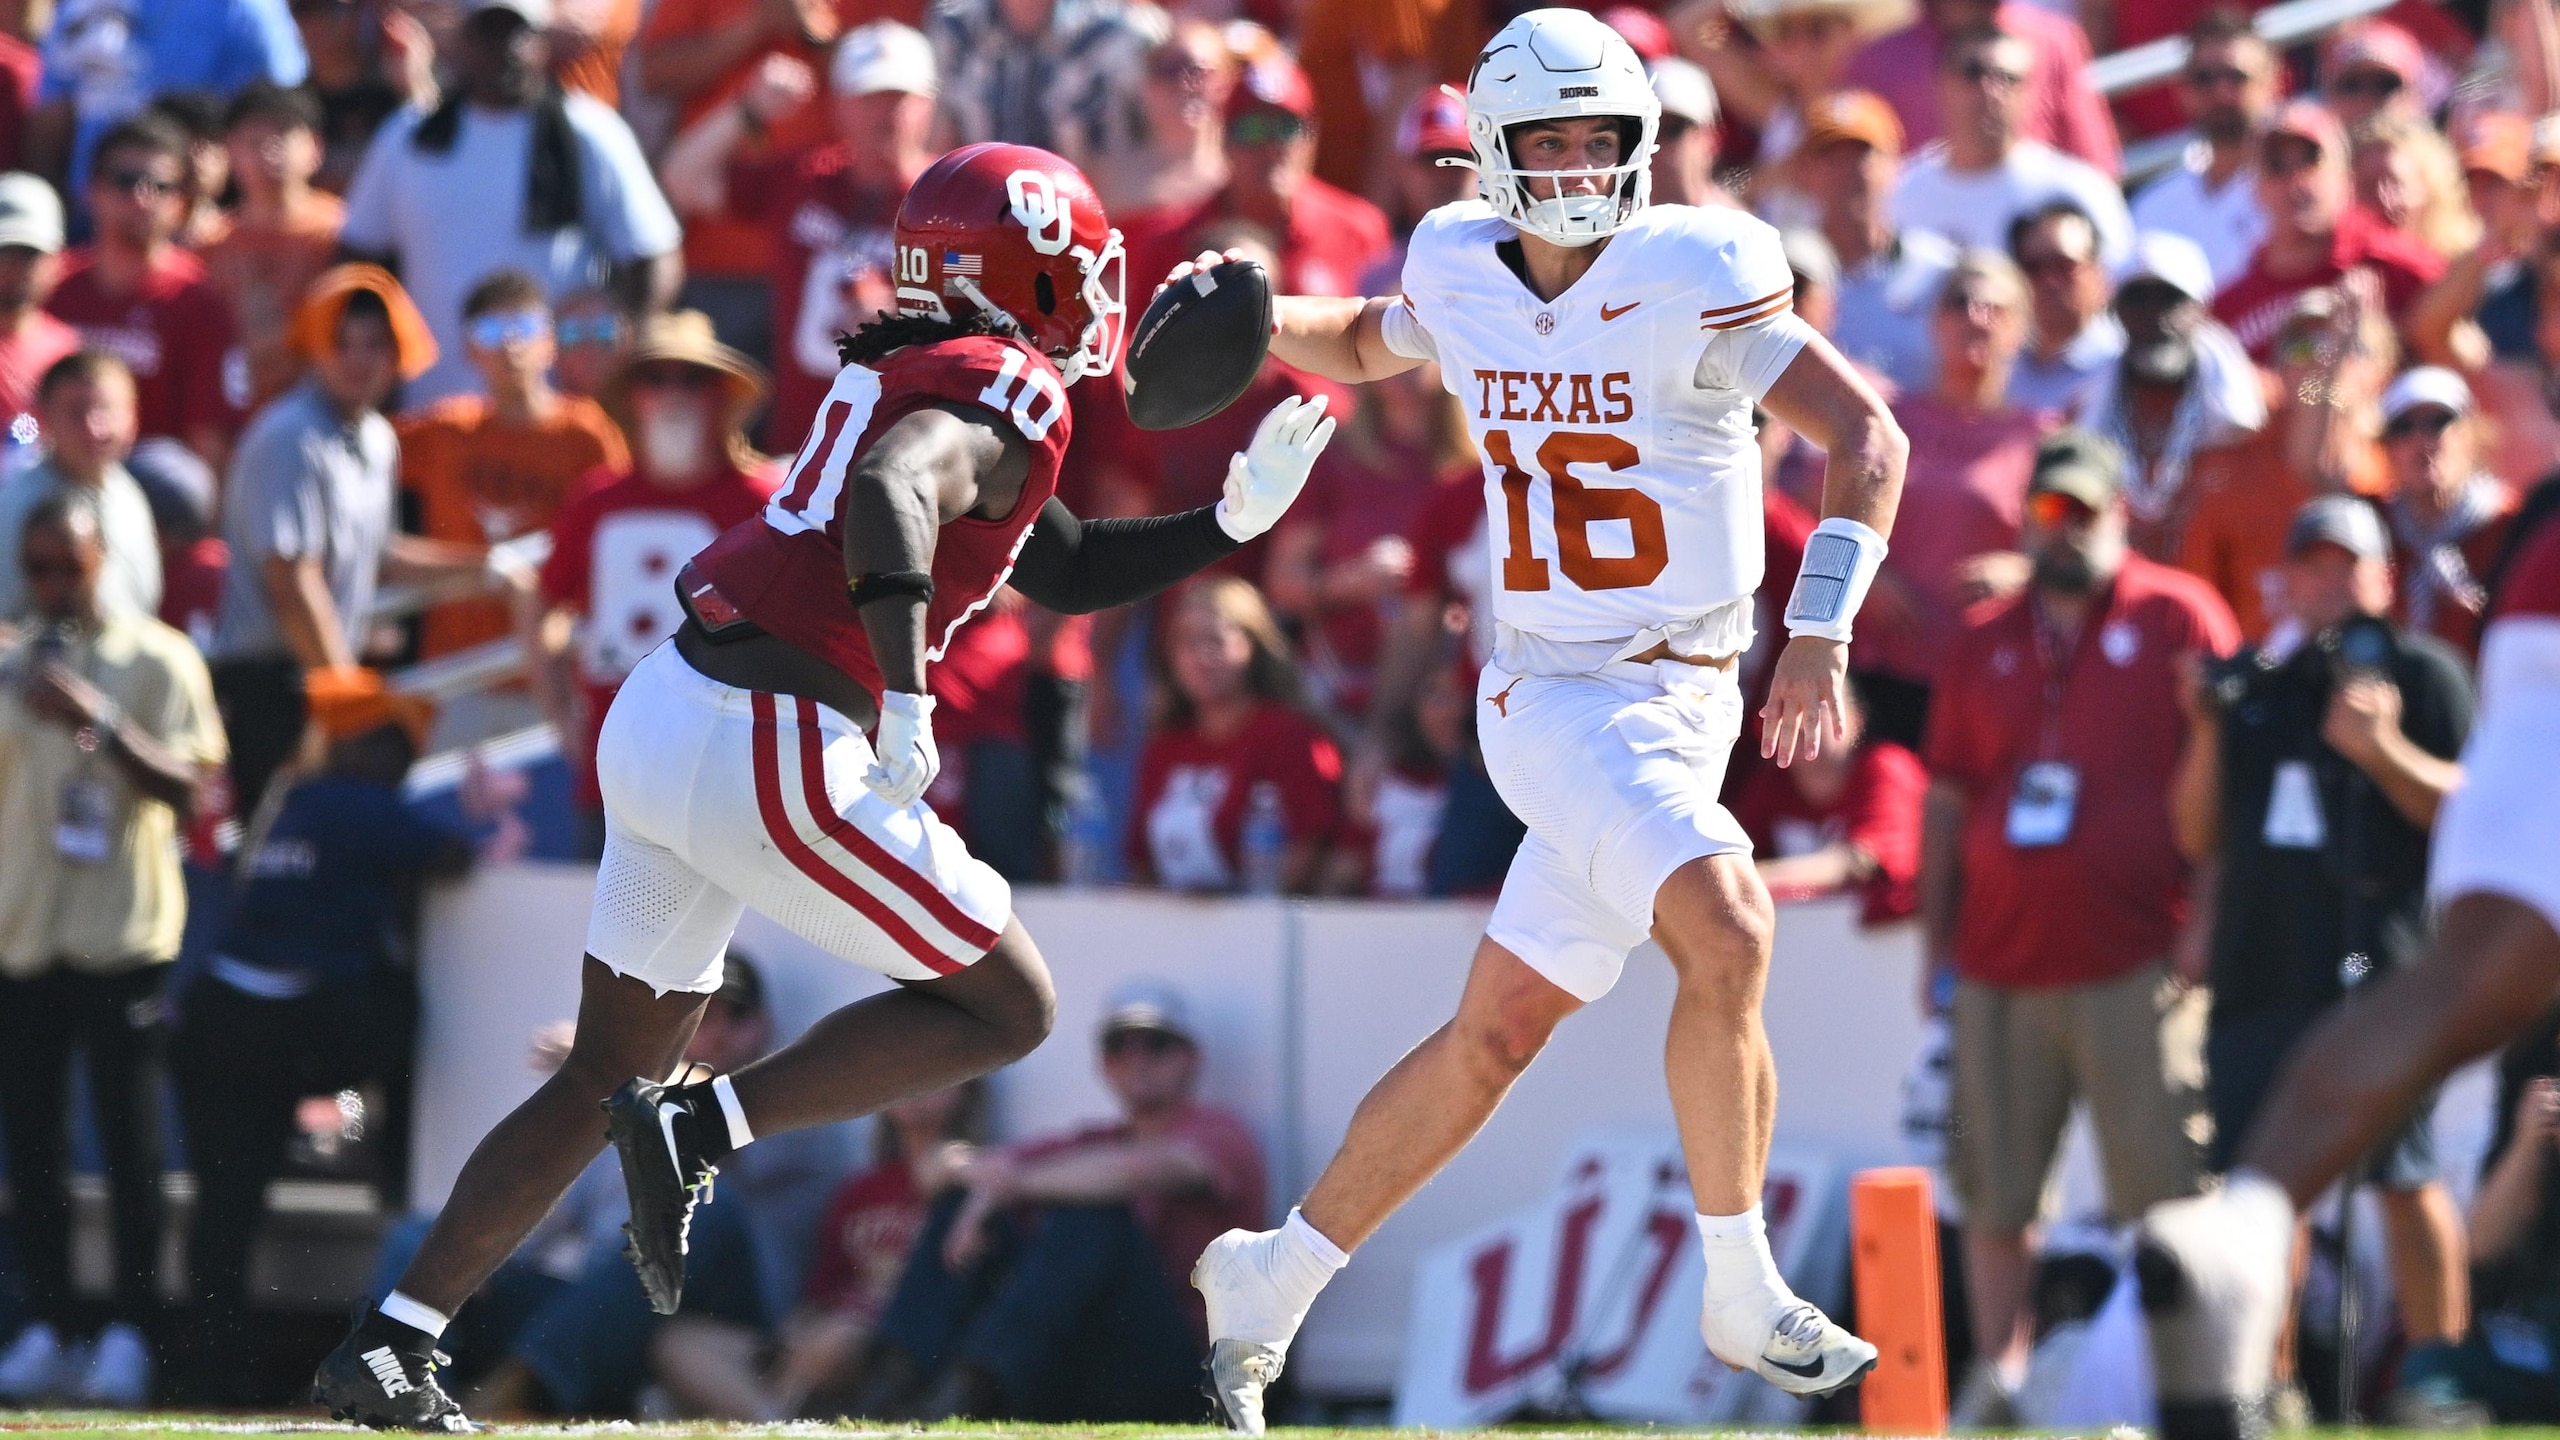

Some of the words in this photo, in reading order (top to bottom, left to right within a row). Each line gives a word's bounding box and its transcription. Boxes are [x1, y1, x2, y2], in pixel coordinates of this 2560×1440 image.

[1559, 86, 1599, 99] HORNS
[1006, 169, 1072, 256] OU
[900, 245, 928, 284] 10
[978, 347, 1066, 441] 10
[1473, 369, 1634, 424] TEXAS
[1484, 430, 1669, 591] 16
[360, 1345, 409, 1399] NIKE
